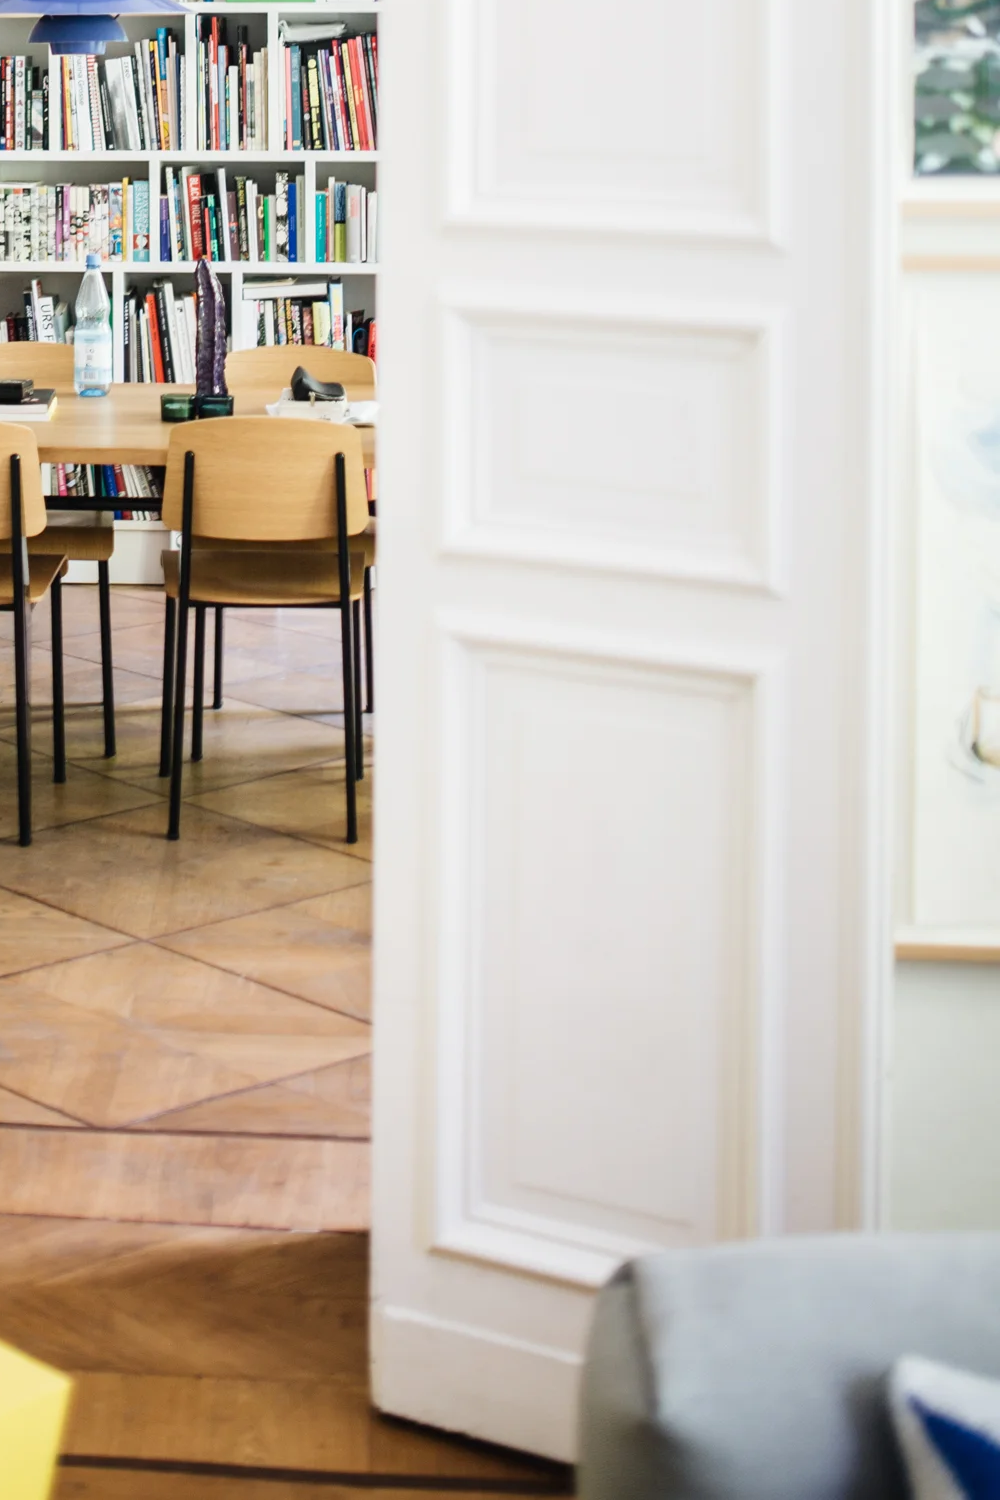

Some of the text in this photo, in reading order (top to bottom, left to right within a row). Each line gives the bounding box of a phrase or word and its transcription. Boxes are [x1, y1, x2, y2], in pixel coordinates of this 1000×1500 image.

[190, 177, 200, 225] BLACK HOLE
[41, 304, 53, 330] URS
